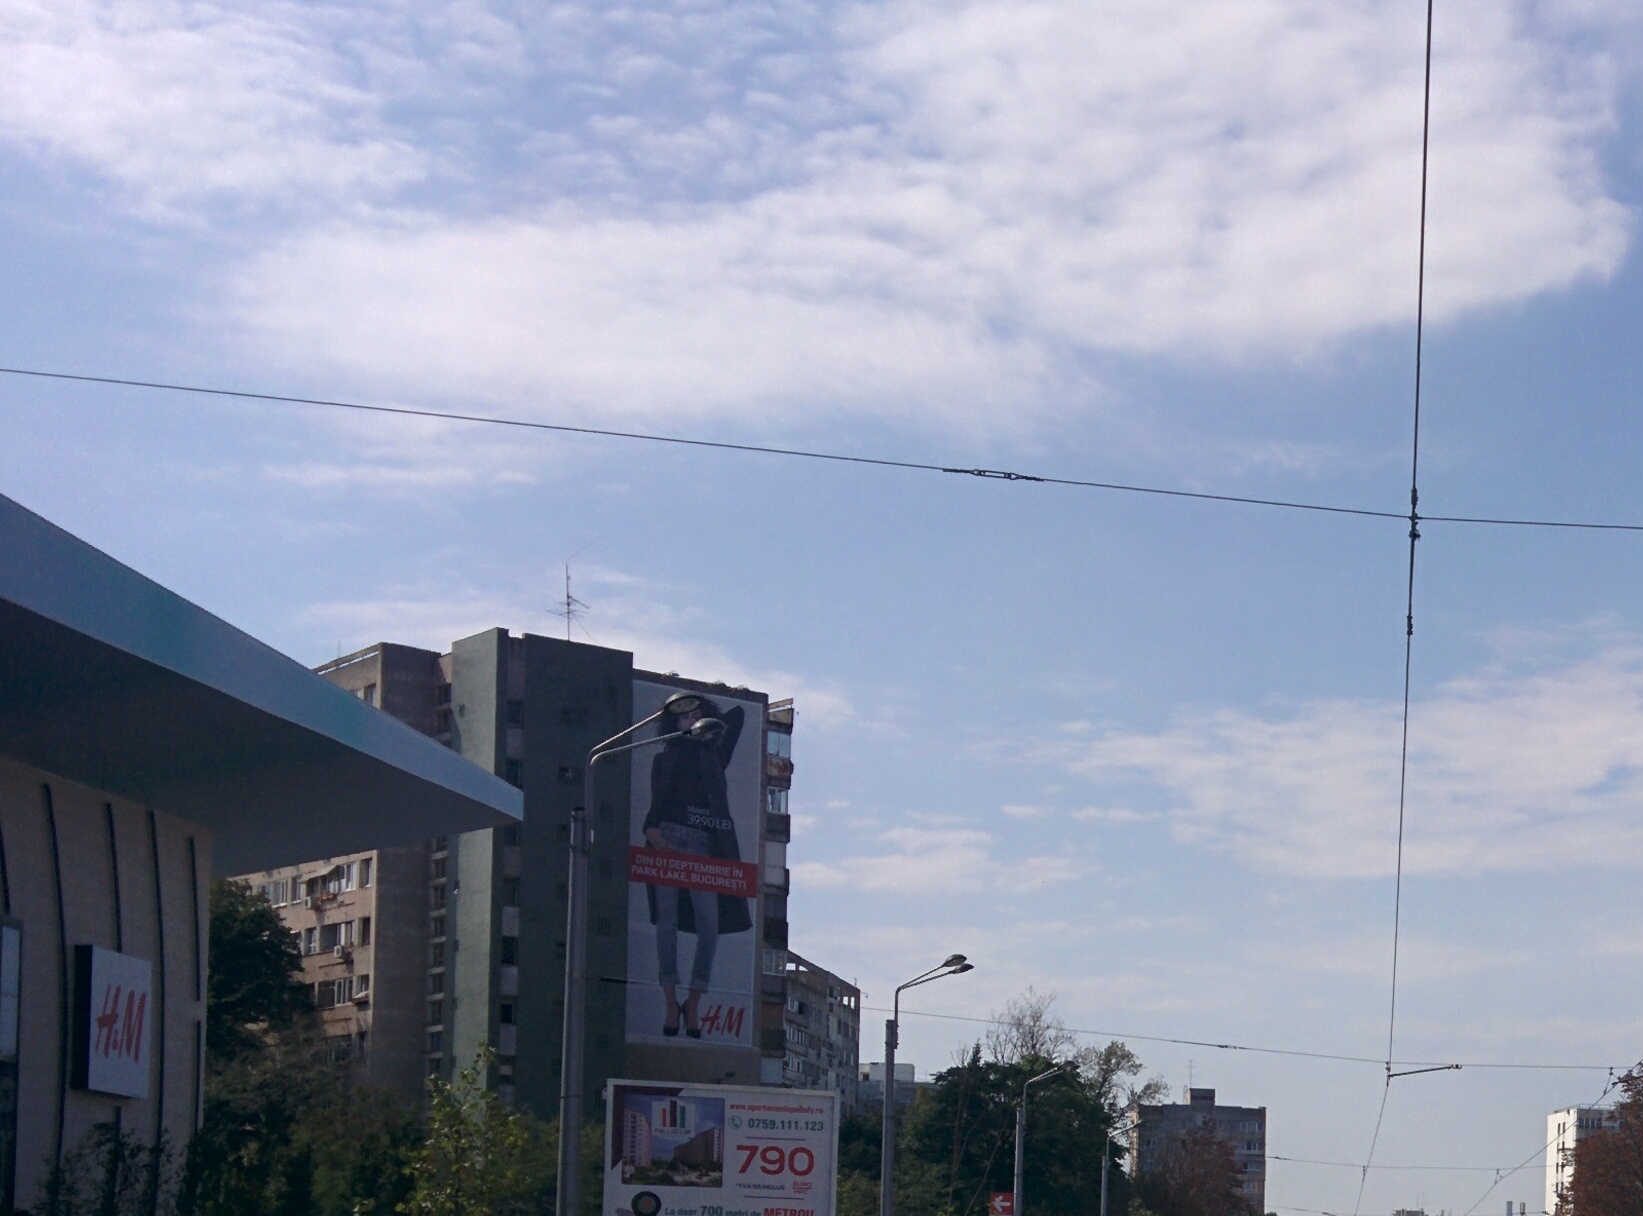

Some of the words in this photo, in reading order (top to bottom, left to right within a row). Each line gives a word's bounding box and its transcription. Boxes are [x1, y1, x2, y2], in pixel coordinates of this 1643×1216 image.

[716, 818, 732, 830] LEI
[631, 865, 658, 877] PARK
[636, 854, 654, 865] DIN
[655, 857, 667, 867] 01
[668, 859, 730, 877] SEPTEMBRIE
[95, 983, 147, 1064] H&M
[700, 1003, 746, 1039] H&M
[747, 1118, 824, 1131] 0759.111.123
[736, 1145, 815, 1177] 790
[665, 1207, 676, 1216] La
[677, 1208, 697, 1216] doar
